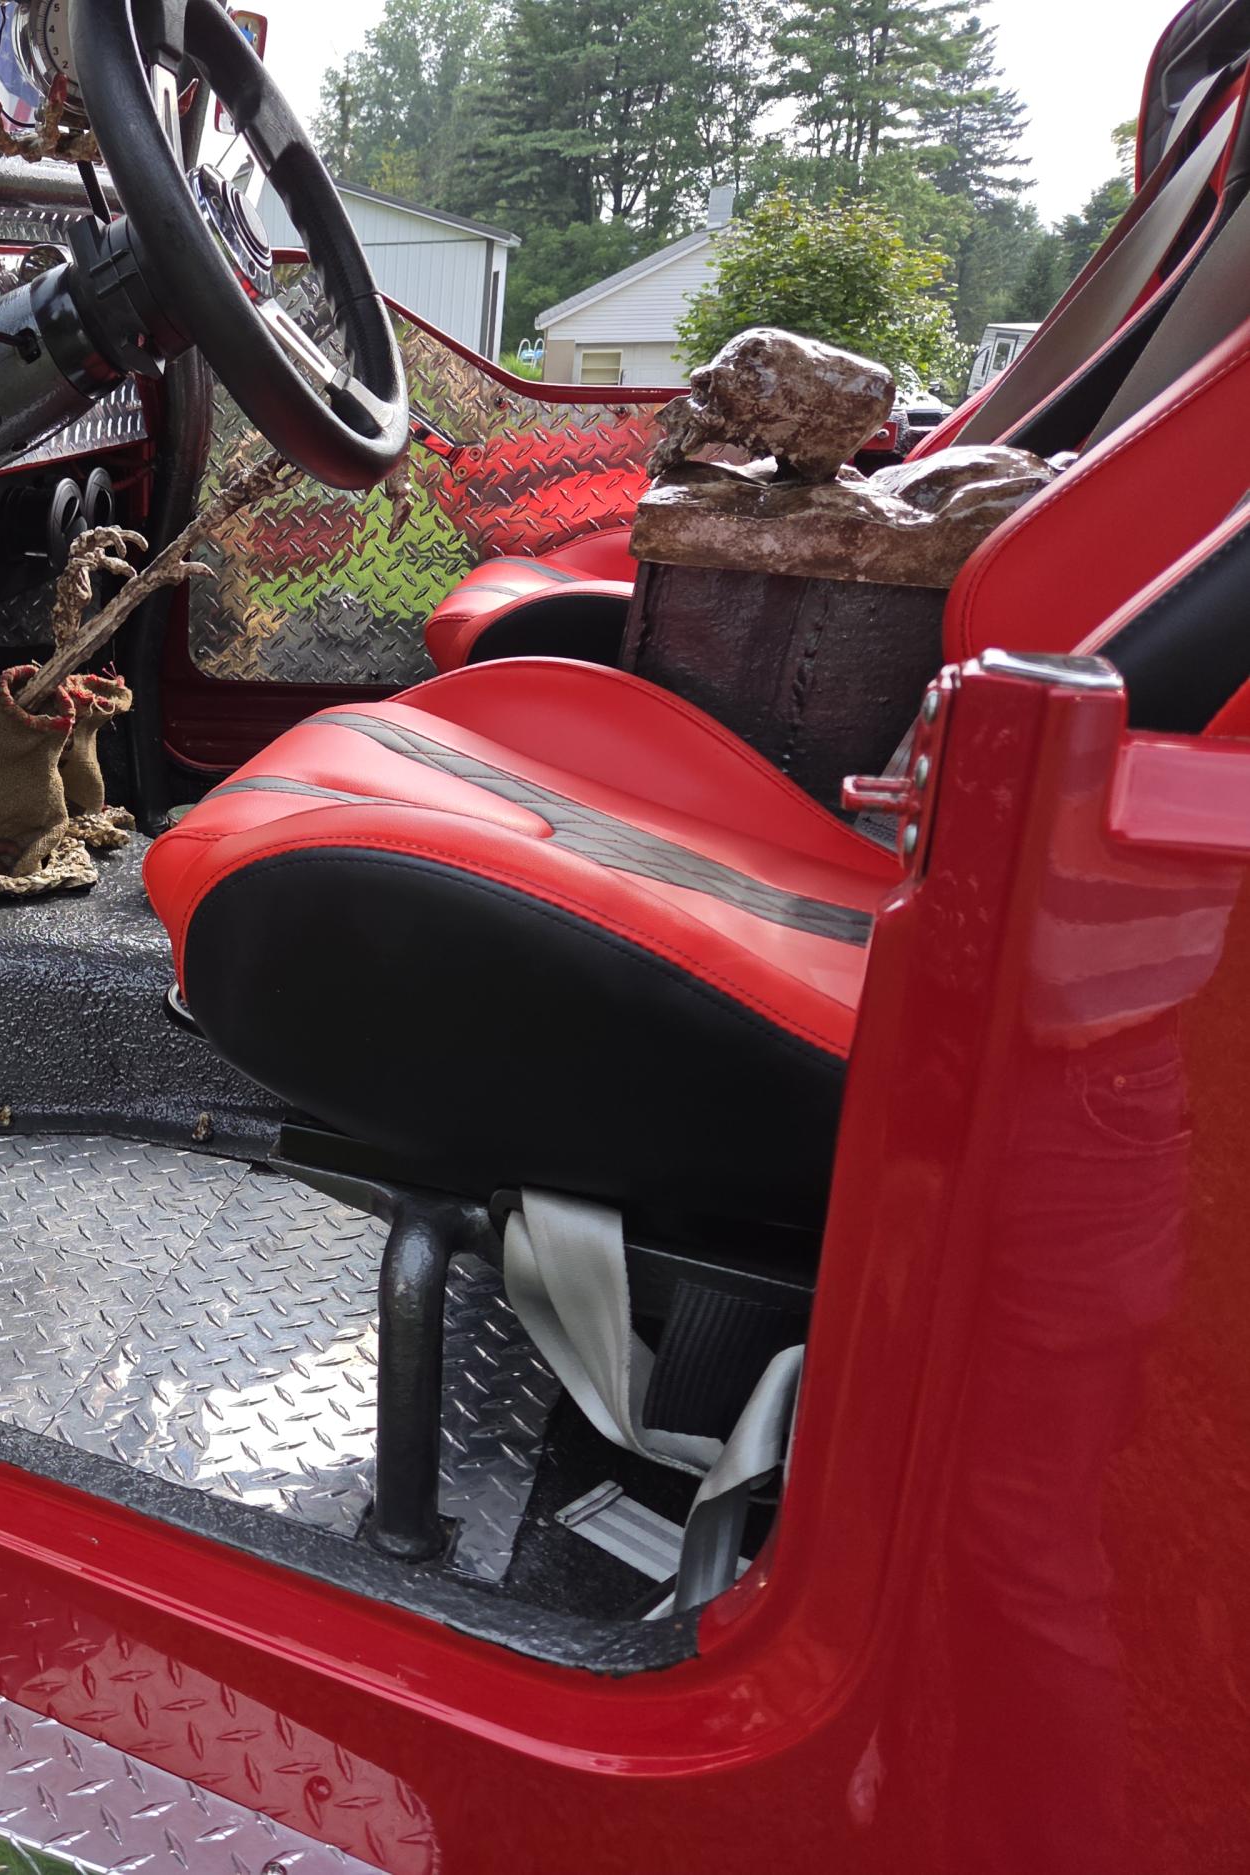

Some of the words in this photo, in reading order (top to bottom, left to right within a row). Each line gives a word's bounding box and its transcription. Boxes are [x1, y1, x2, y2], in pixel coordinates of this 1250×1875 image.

[54, 3, 60, 12] 5
[49, 25, 55, 33] 4
[53, 47, 59, 56] 3
[62, 61, 69, 69] 2
